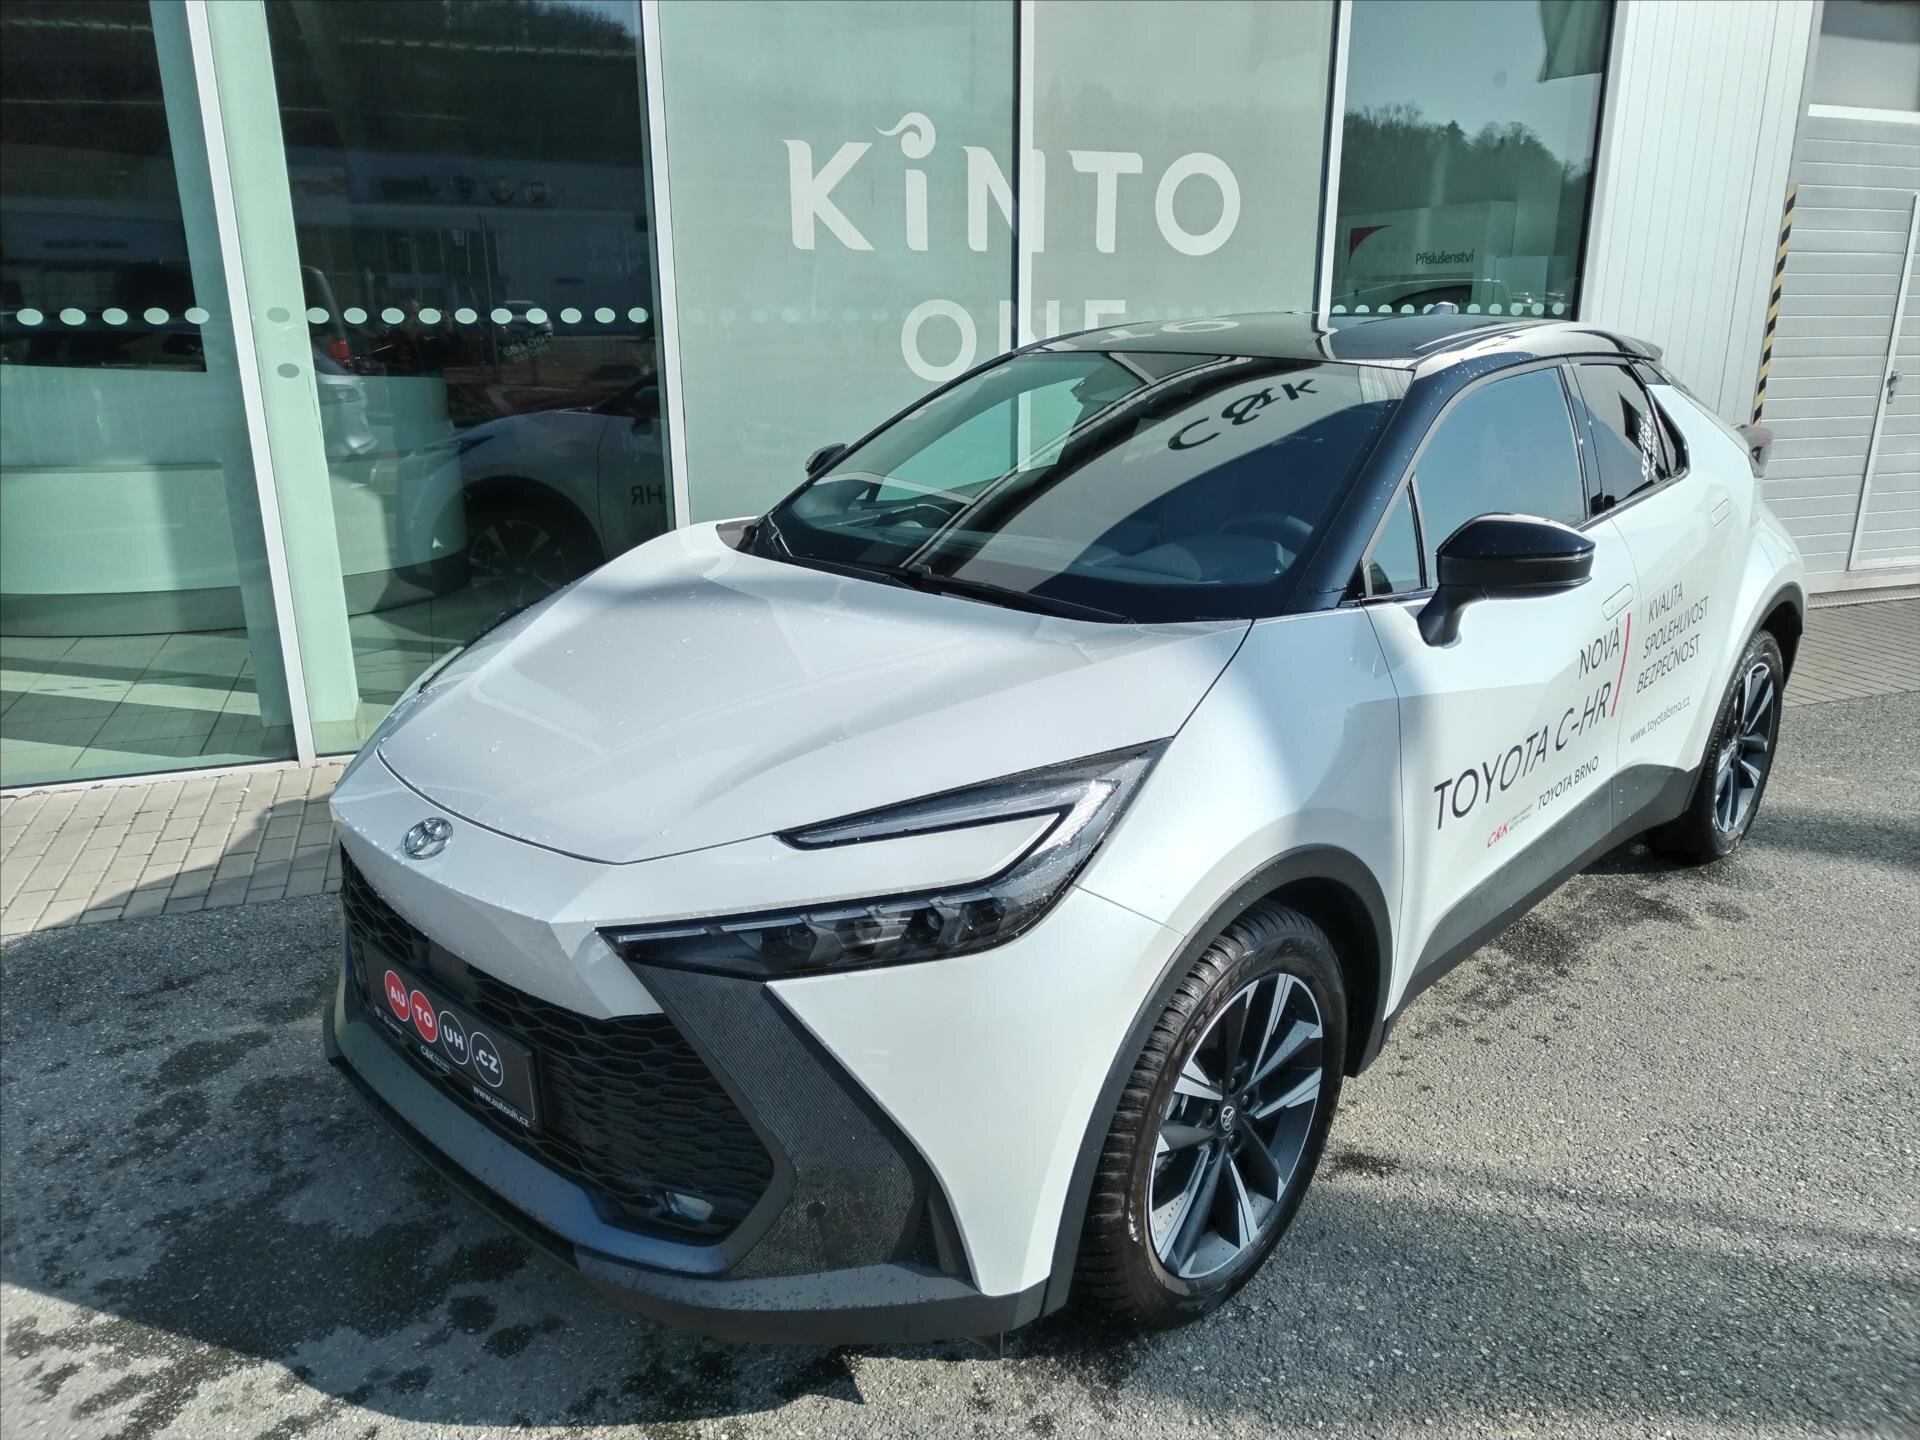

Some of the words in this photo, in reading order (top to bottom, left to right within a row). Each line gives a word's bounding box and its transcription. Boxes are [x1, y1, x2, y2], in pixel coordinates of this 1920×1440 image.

[1415, 248, 1475, 265] Příslušenství
[1643, 596, 1709, 659] SPOLEHLIVOST
[1648, 582, 1684, 623] KVALITA
[1578, 617, 1620, 680] NOVÁ
[1636, 634, 1701, 694] BEZPEČNOST
[1629, 696, 1691, 744] www.toyotabrno.cz
[1433, 726, 1548, 830] TOYOTA
[1555, 682, 1612, 751] C-HR
[1537, 773, 1572, 811] TOYOTA
[1574, 755, 1599, 784] BRNO
[472, 1083, 530, 1128] www.autouh.cz
